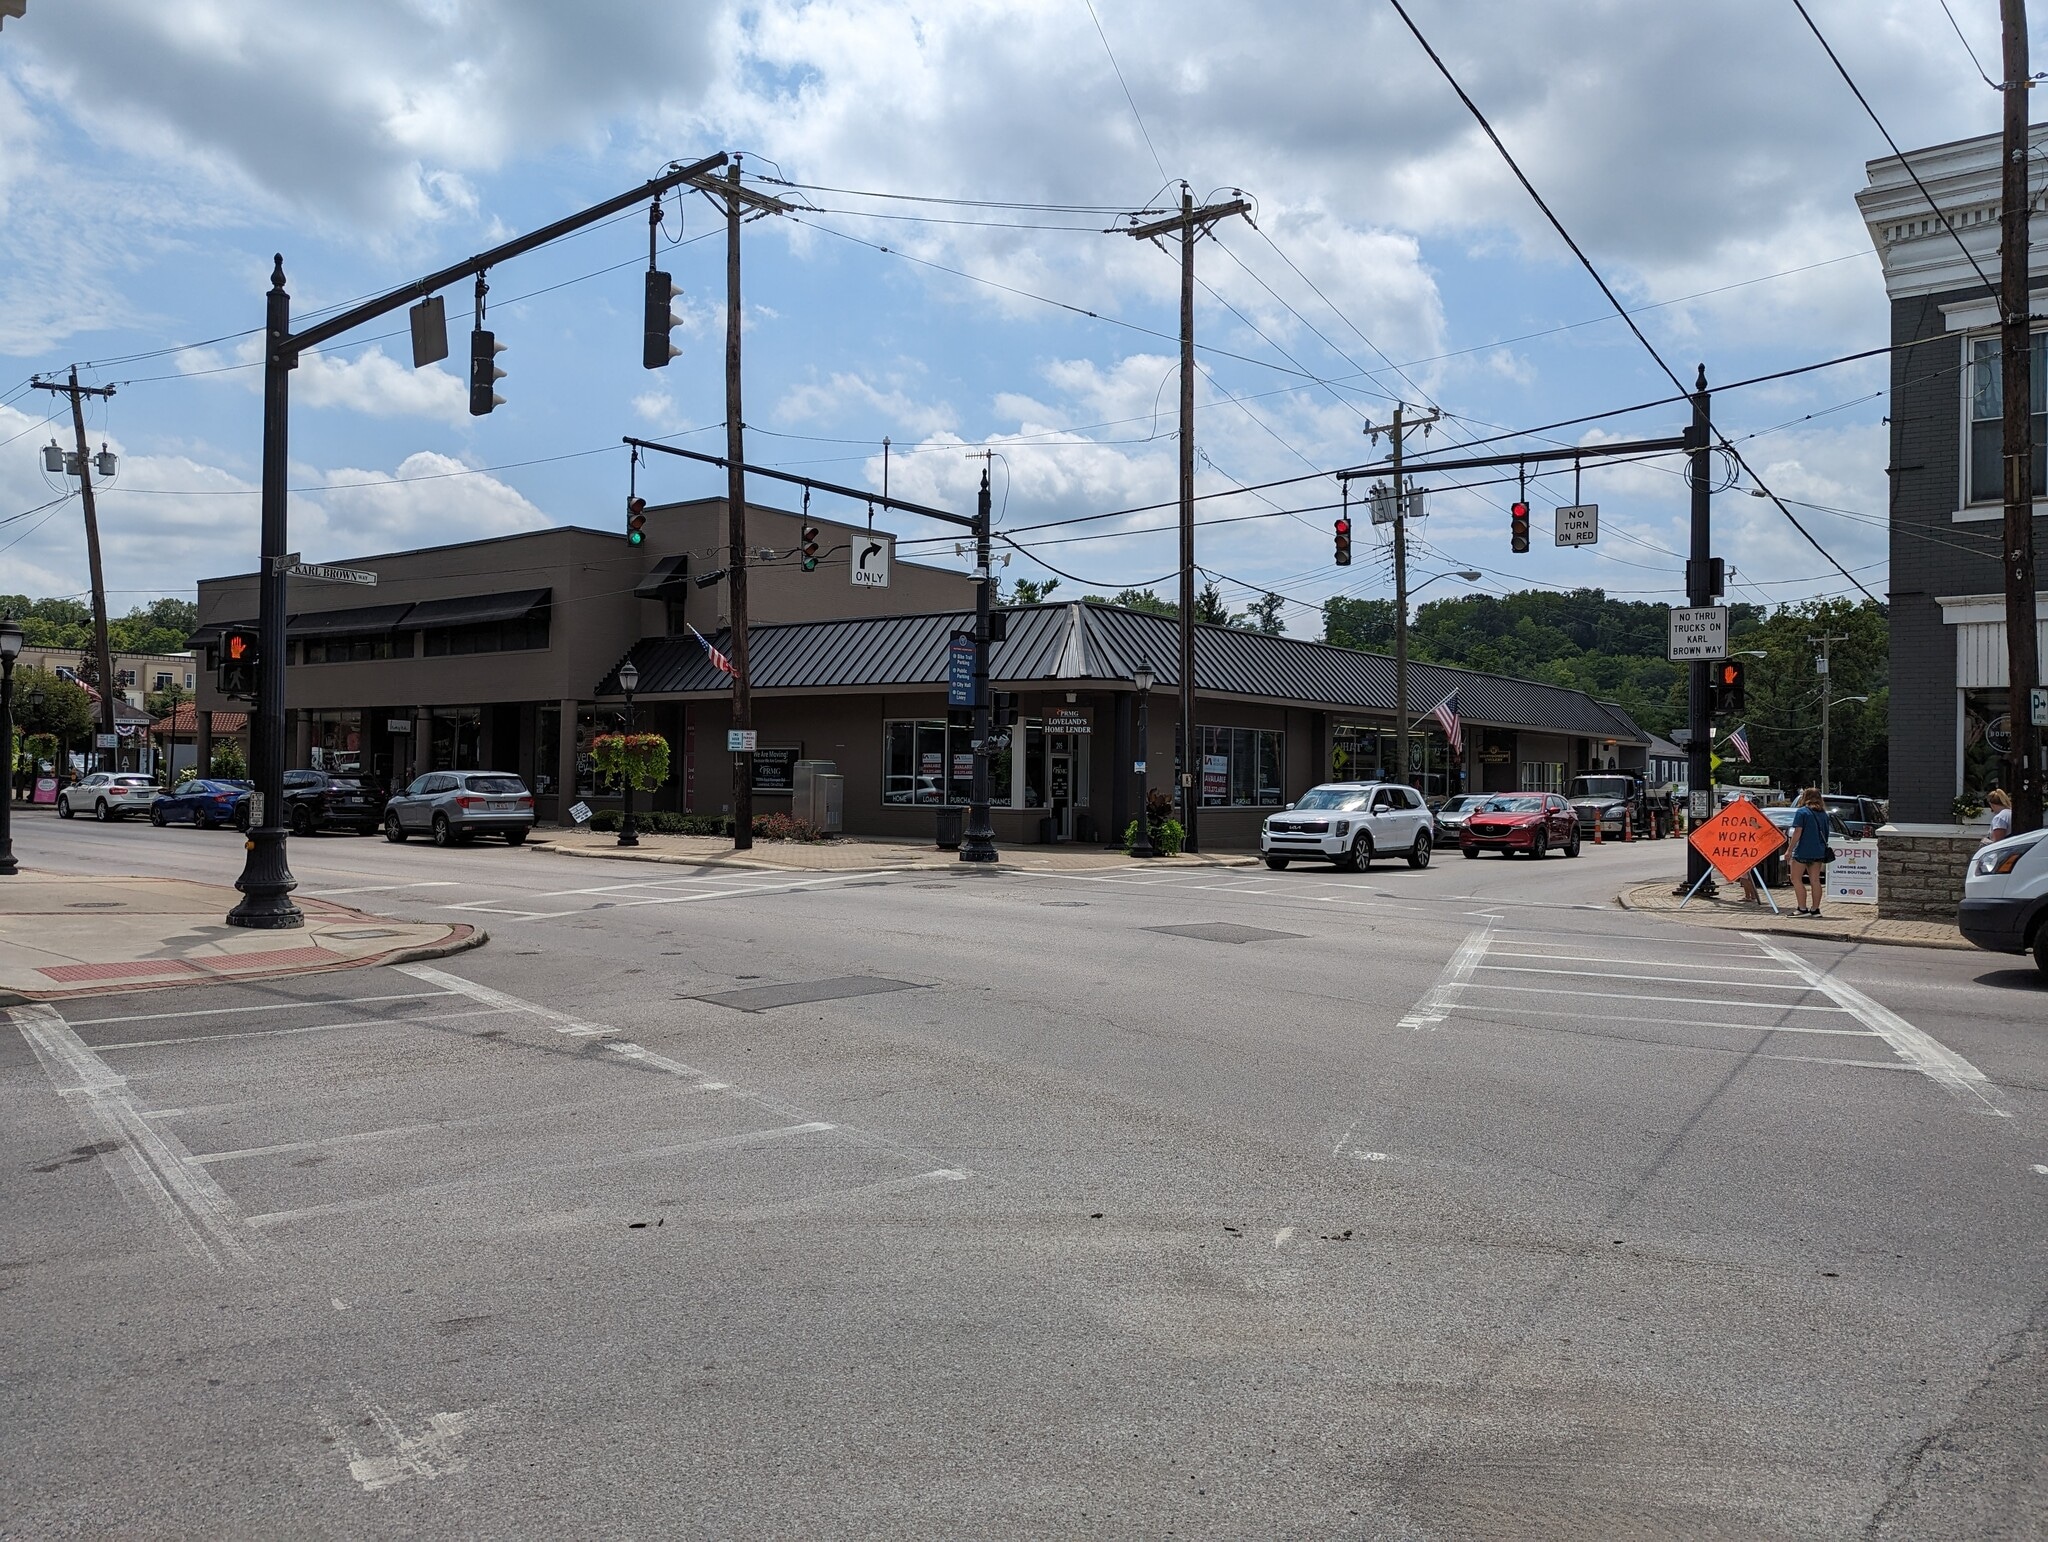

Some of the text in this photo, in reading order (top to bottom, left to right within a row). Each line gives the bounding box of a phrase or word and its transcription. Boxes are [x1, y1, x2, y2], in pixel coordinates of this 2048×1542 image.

[1568, 510, 1584, 519] NO
[1564, 521, 1589, 530] TURN
[1576, 532, 1594, 540] RED
[295, 566, 321, 576] KARL
[323, 567, 357, 580] BROWN
[856, 572, 884, 583] ONLY
[1679, 612, 1716, 621] NO THRU
[1674, 623, 1721, 632] TRUCKS ON
[1687, 635, 1708, 643] KARL
[1673, 646, 1722, 655] BROWN WAY
[769, 751, 788, 759] Moving!
[1205, 775, 1226, 783] AVAILABLE
[1721, 817, 1758, 826] ROAD
[1718, 832, 1756, 842] WORK
[1712, 847, 1758, 857] AHEAD
[1834, 849, 1871, 858] OPEN
